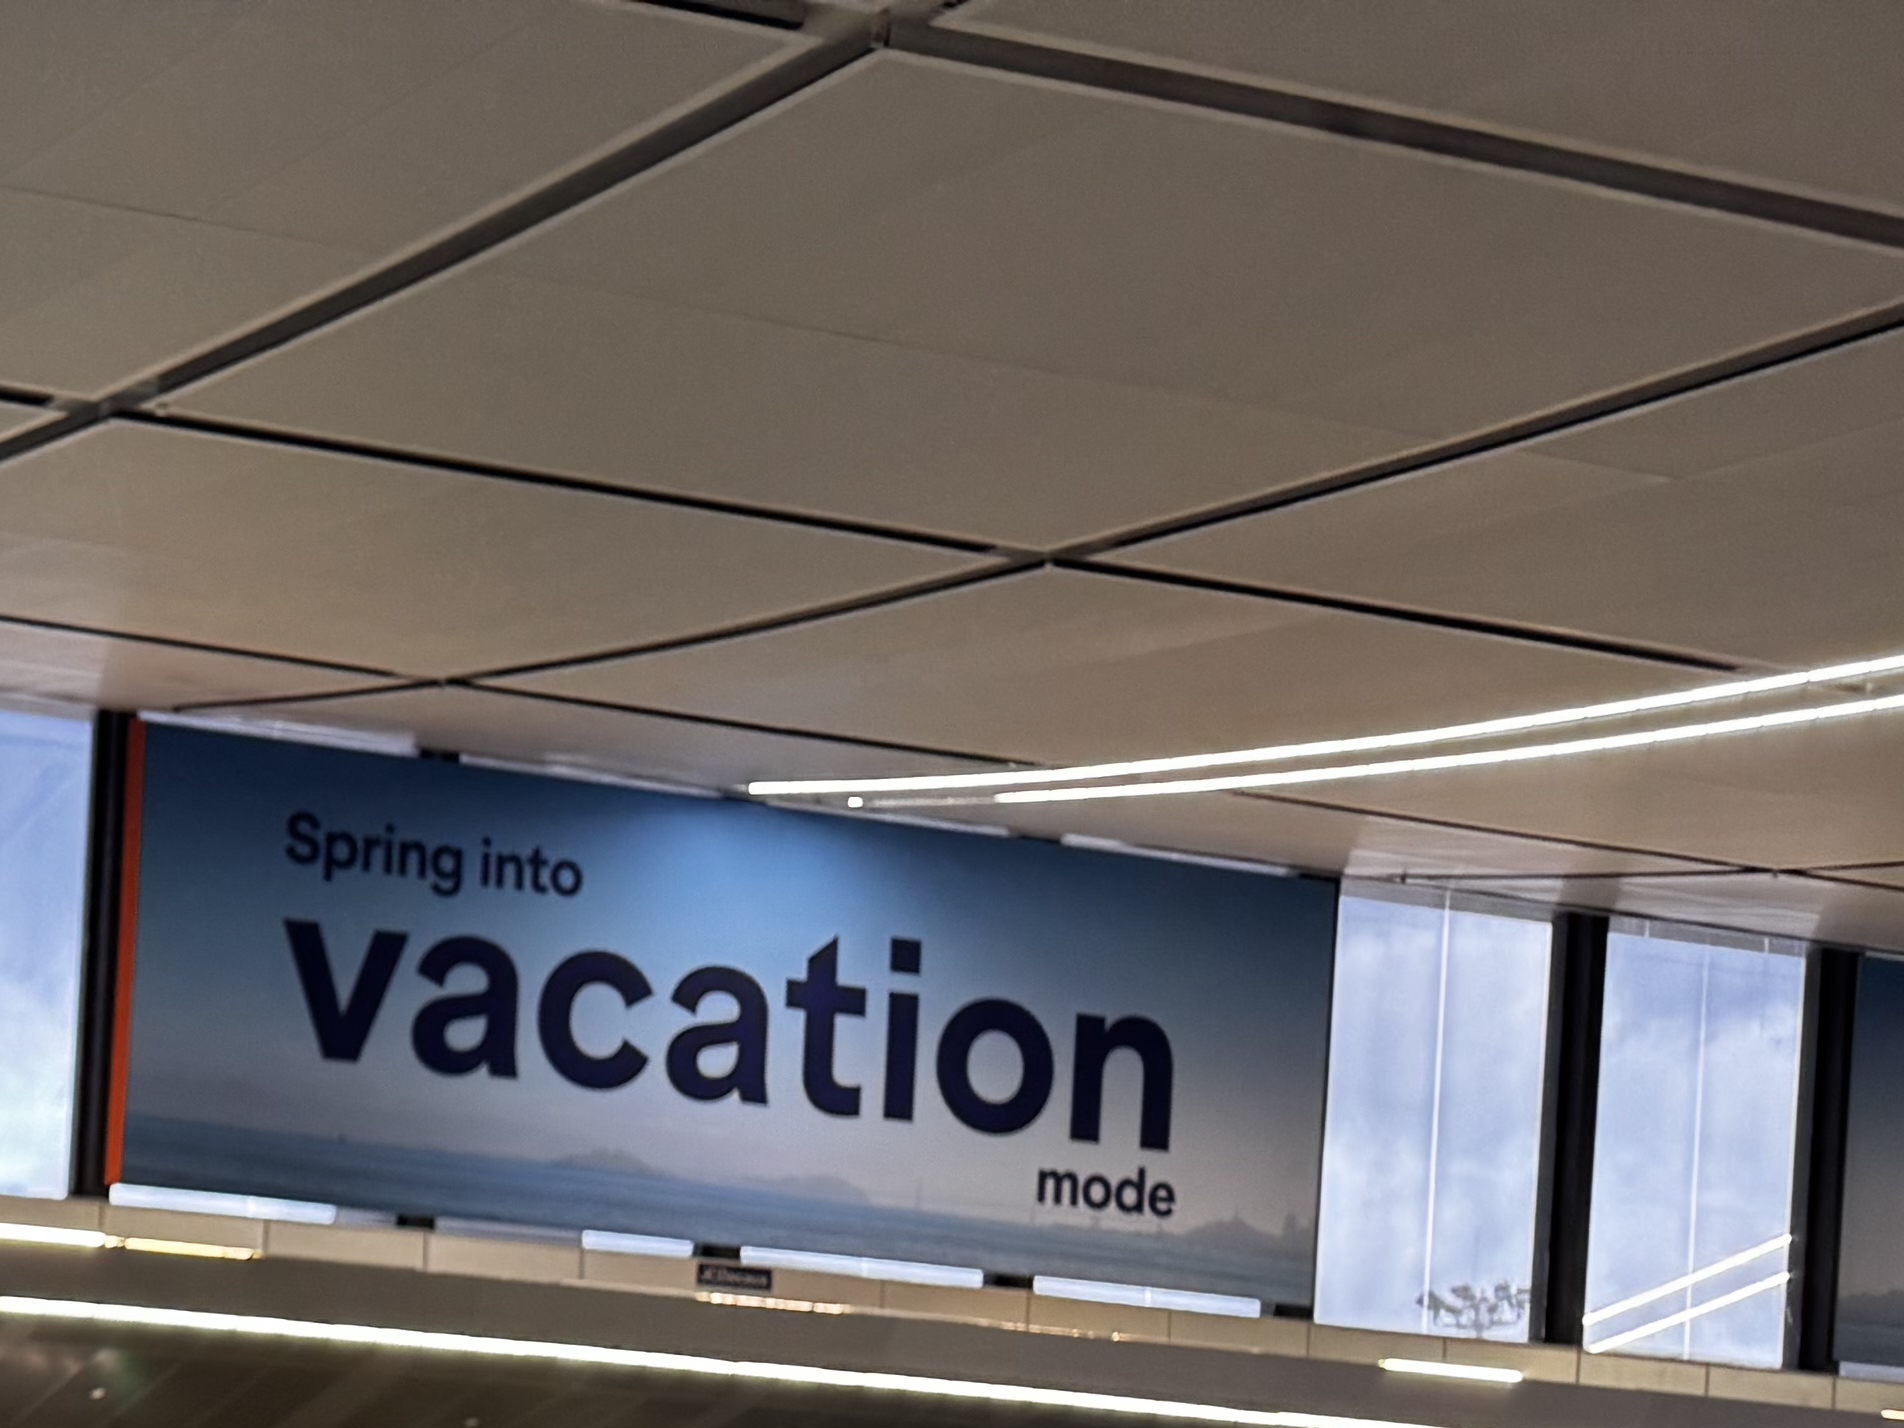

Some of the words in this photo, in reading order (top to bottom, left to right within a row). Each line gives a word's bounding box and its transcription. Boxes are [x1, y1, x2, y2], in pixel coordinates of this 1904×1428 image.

[283, 811, 464, 898] Spring
[479, 836, 584, 898] into
[282, 919, 1176, 1153] vacation
[1036, 1164, 1177, 1219] mode
